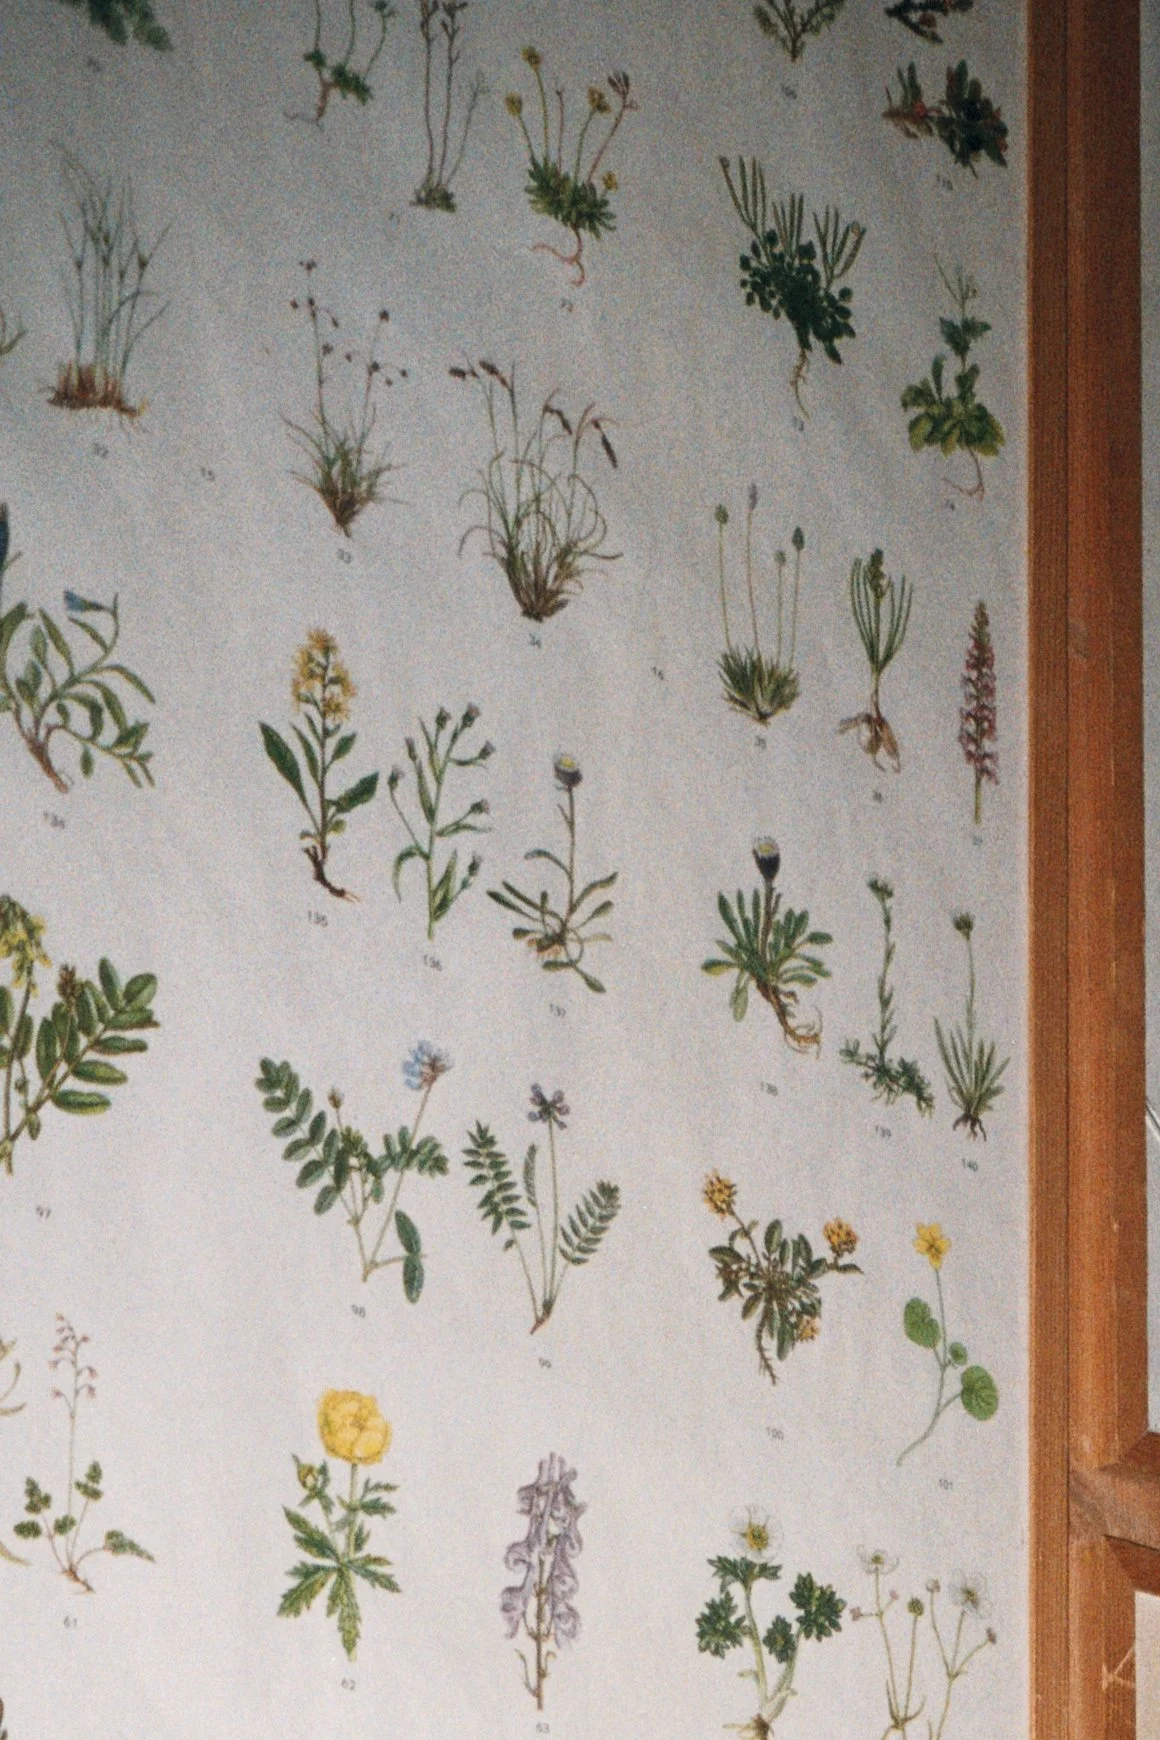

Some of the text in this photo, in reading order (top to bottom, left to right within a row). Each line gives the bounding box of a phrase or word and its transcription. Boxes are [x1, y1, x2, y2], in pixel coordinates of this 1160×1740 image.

[35, 1205, 52, 1219] 97
[351, 1304, 366, 1318] 98
[766, 1426, 784, 1440] 100
[938, 1478, 953, 1490] 101
[63, 1616, 77, 1629] 61
[341, 1678, 355, 1691] 62
[536, 1722, 550, 1734] 63
